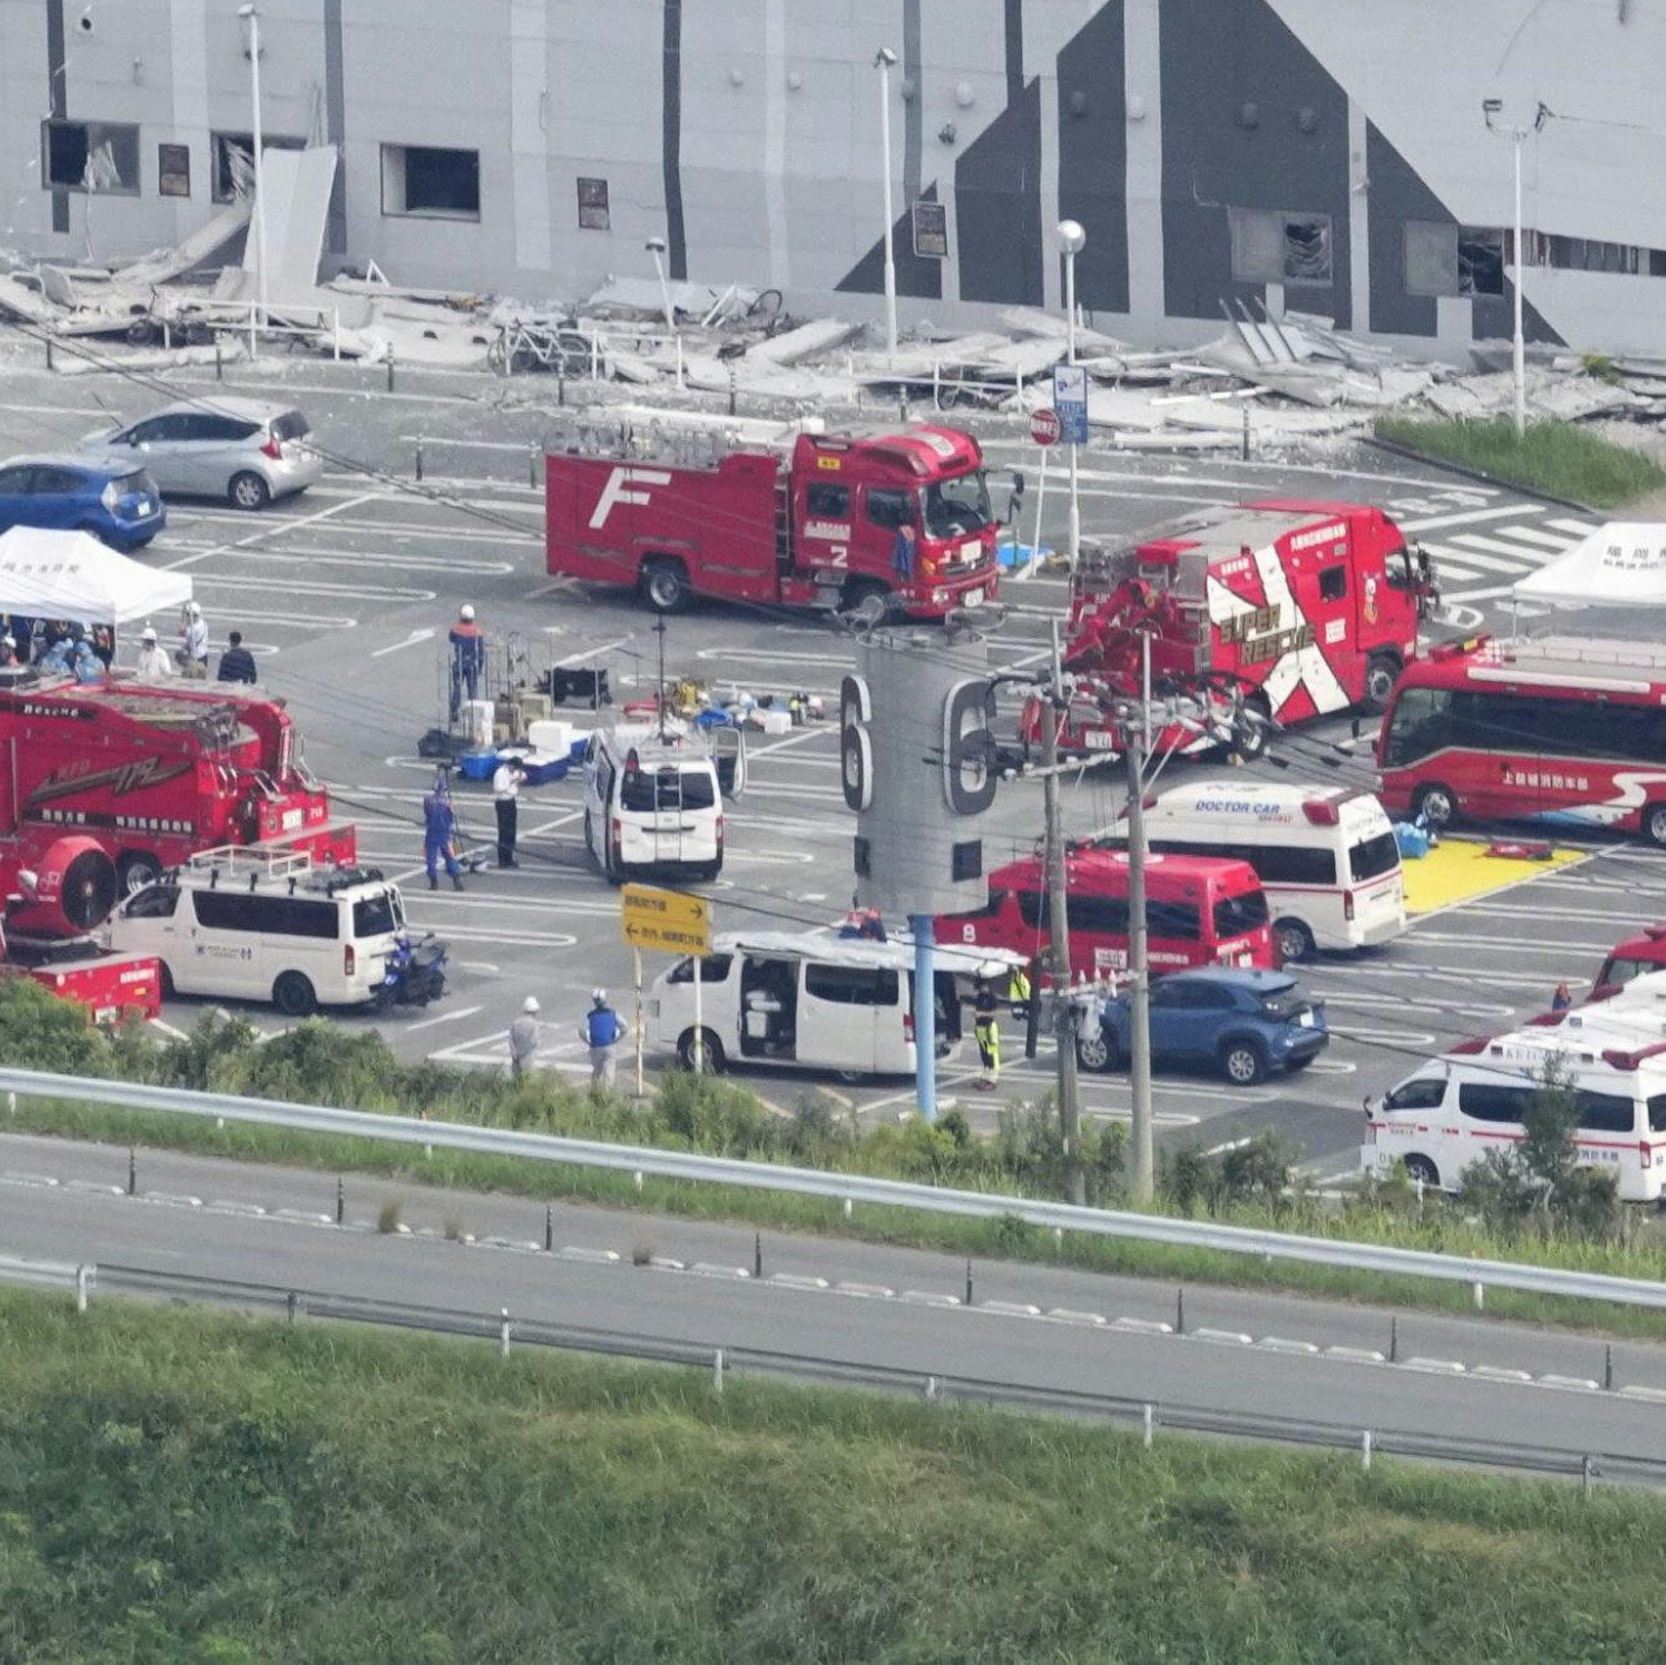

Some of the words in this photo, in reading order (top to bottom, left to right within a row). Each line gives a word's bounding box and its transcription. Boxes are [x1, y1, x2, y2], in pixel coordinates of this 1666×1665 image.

[589, 466, 672, 529] F
[831, 545, 848, 569] 2
[1220, 603, 1281, 644] SUPER
[1241, 623, 1315, 666] RESCUE
[1195, 800, 1249, 814] DOCTOR
[1253, 802, 1281, 814] CAR
